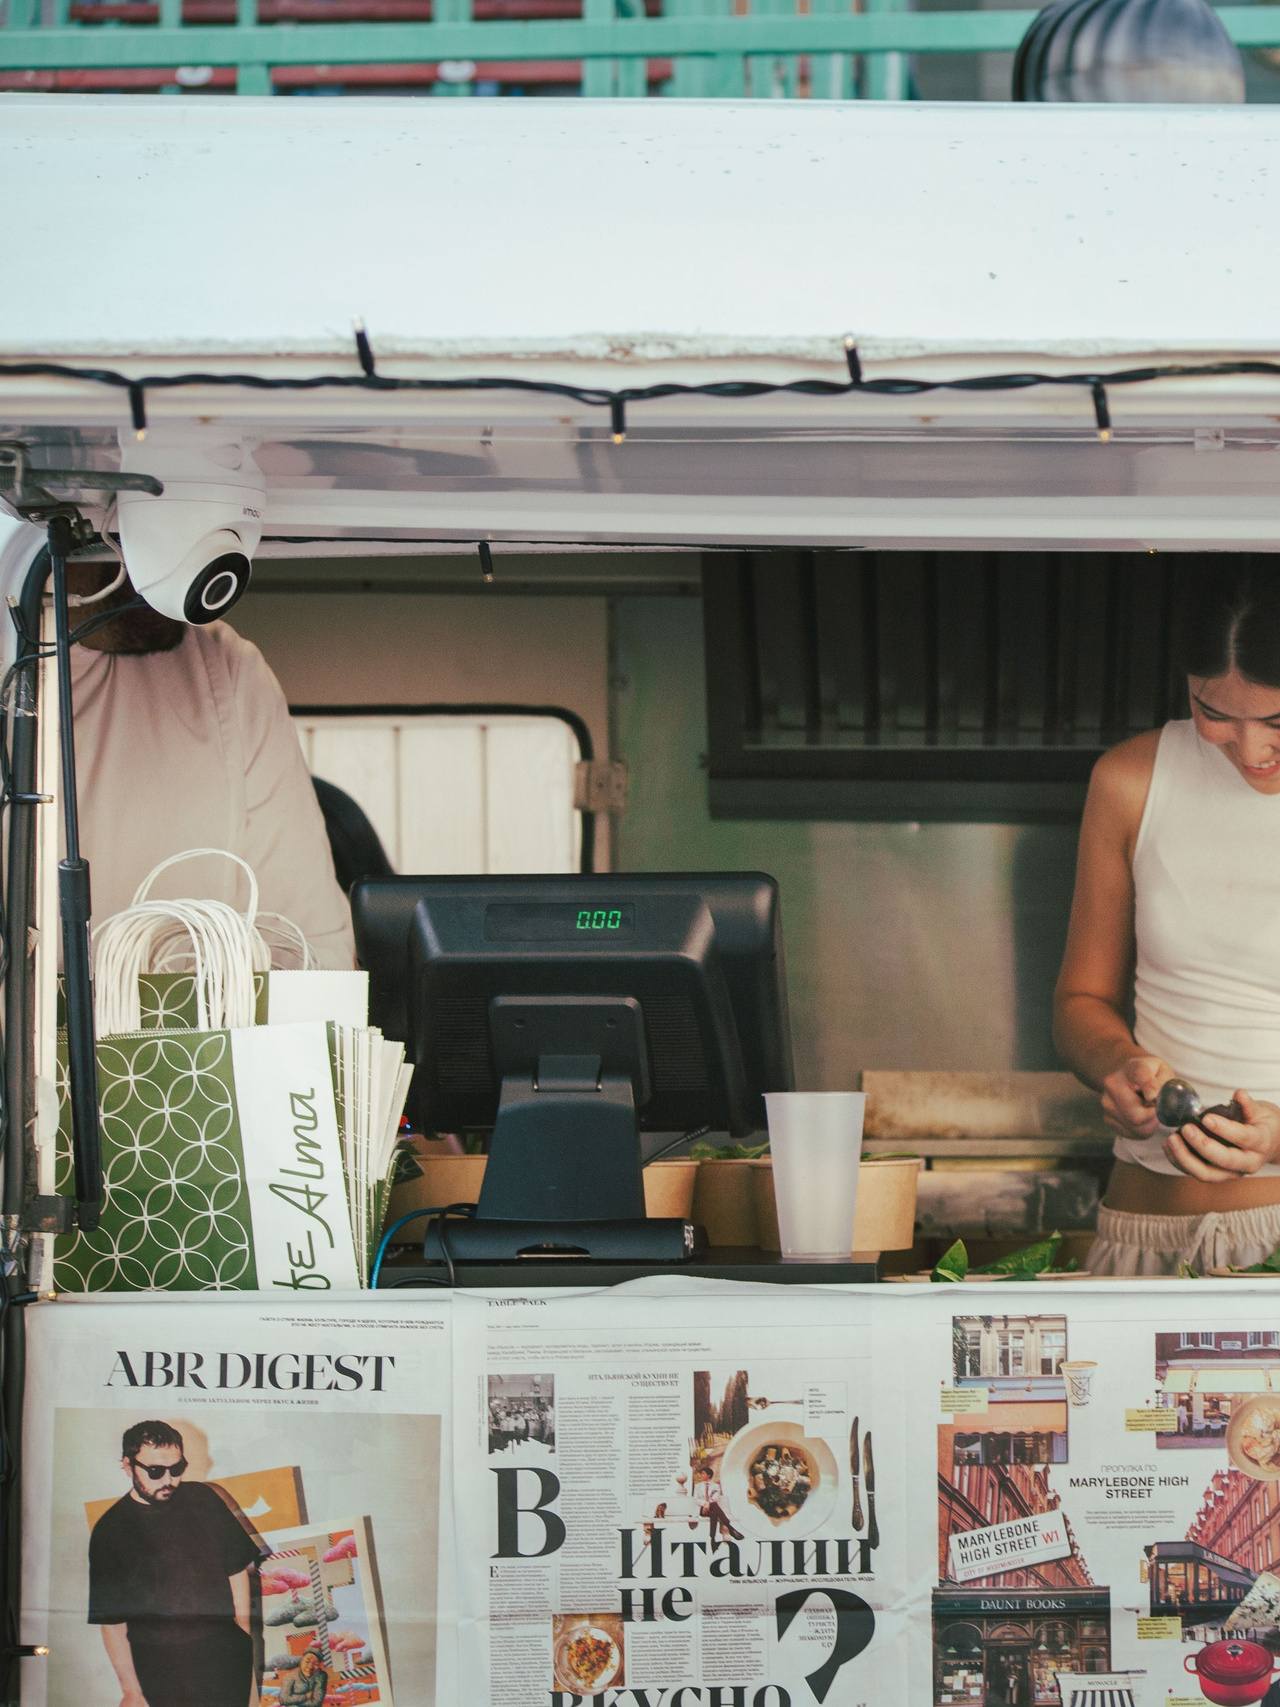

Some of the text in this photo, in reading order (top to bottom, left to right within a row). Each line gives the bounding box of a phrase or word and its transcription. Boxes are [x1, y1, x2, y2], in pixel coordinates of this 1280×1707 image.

[576, 910, 622, 929] 0.00
[268, 1087, 335, 1249] Alma
[103, 1350, 396, 1392] ABR DIGEST
[588, 1373, 641, 1381] ИТАЛЬЯНСКОЙ
[631, 1380, 679, 1389] СУЩЕСТВУЕТ
[1101, 1464, 1142, 1473] ПРОГУЛКА
[1069, 1476, 1189, 1487] MARYLEBONE HIGH
[1106, 1488, 1153, 1499] STREET
[489, 1467, 567, 1559] В
[958, 1521, 1040, 1550] MARYLEBONE
[960, 1530, 1060, 1564] HIGH STREET W1
[616, 1527, 875, 1579] Италии
[617, 1587, 693, 1622] не
[981, 1599, 1066, 1610] DAUNT BOOKS
